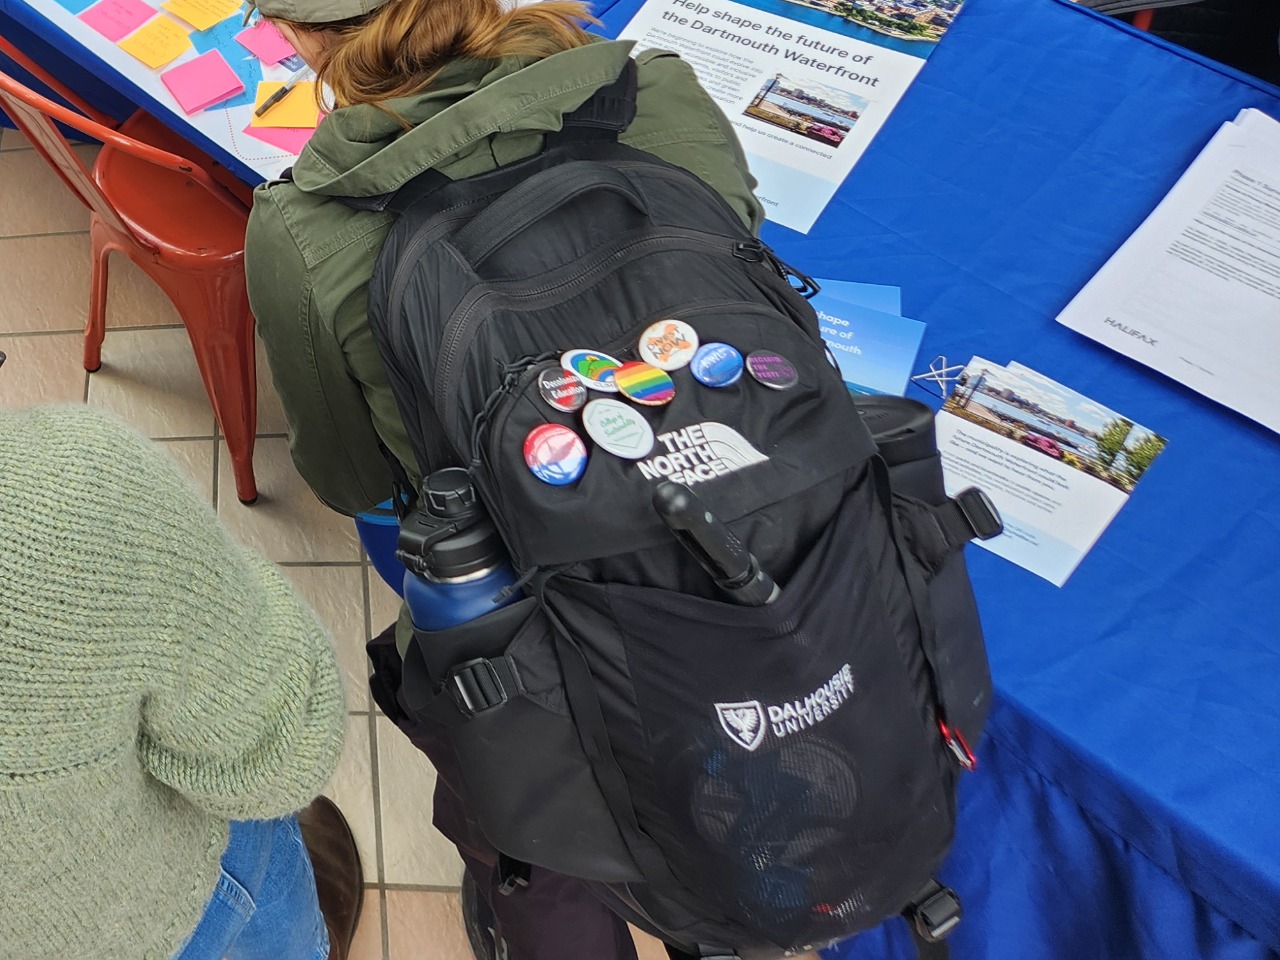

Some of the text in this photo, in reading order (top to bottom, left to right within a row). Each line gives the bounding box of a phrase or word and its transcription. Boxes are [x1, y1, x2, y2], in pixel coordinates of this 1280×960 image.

[662, 10, 880, 88] the Dartmouth Waterfront
[712, 8, 763, 35] shape
[766, 25, 794, 42] the
[797, 33, 848, 59] future
[851, 51, 874, 67] of
[742, 122, 757, 137] help
[759, 129, 767, 137] us
[767, 134, 789, 146] create
[795, 142, 833, 161] connected
[652, 333, 687, 360] NOW
[1104, 316, 1159, 348] HALIFAX
[656, 425, 705, 454] THE
[637, 441, 717, 481] NORTH
[767, 663, 852, 724] DALHOUSIE
[772, 682, 855, 738] UNIVERSITY
